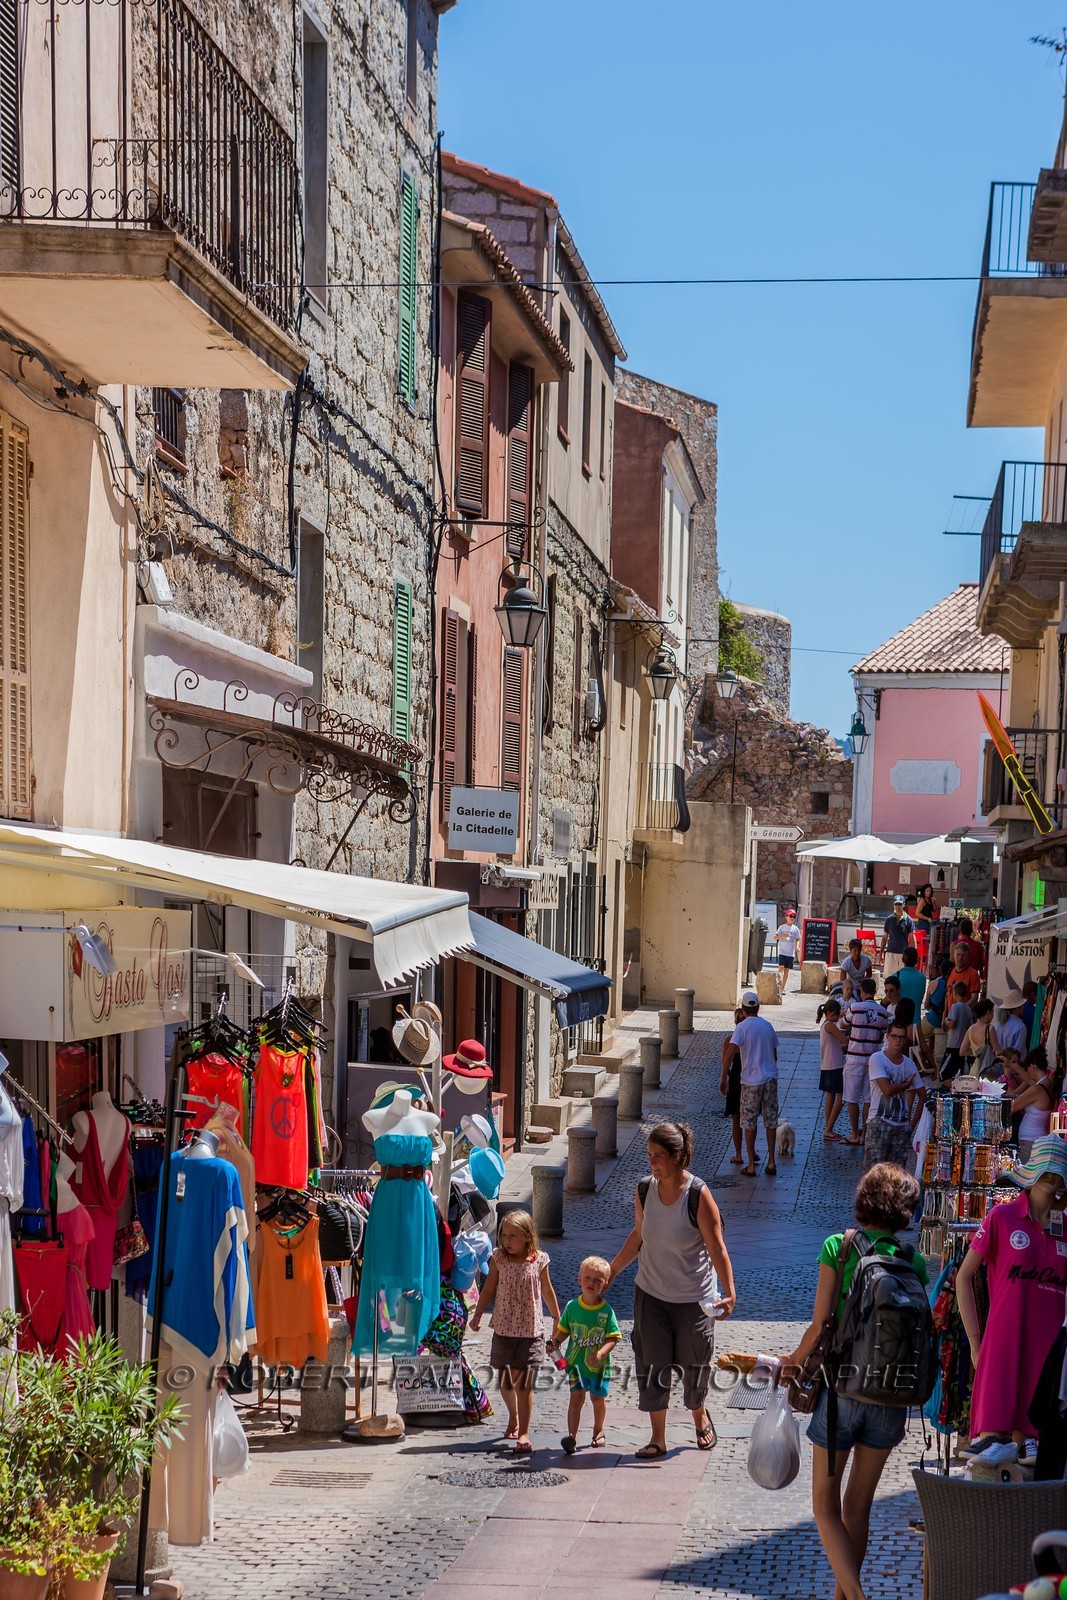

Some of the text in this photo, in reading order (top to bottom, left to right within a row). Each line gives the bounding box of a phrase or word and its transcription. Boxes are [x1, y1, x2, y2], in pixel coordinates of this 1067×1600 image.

[456, 806, 512, 820] Galerie de
[452, 822, 514, 836] la Citadelle
[762, 829, 793, 838] Génoise
